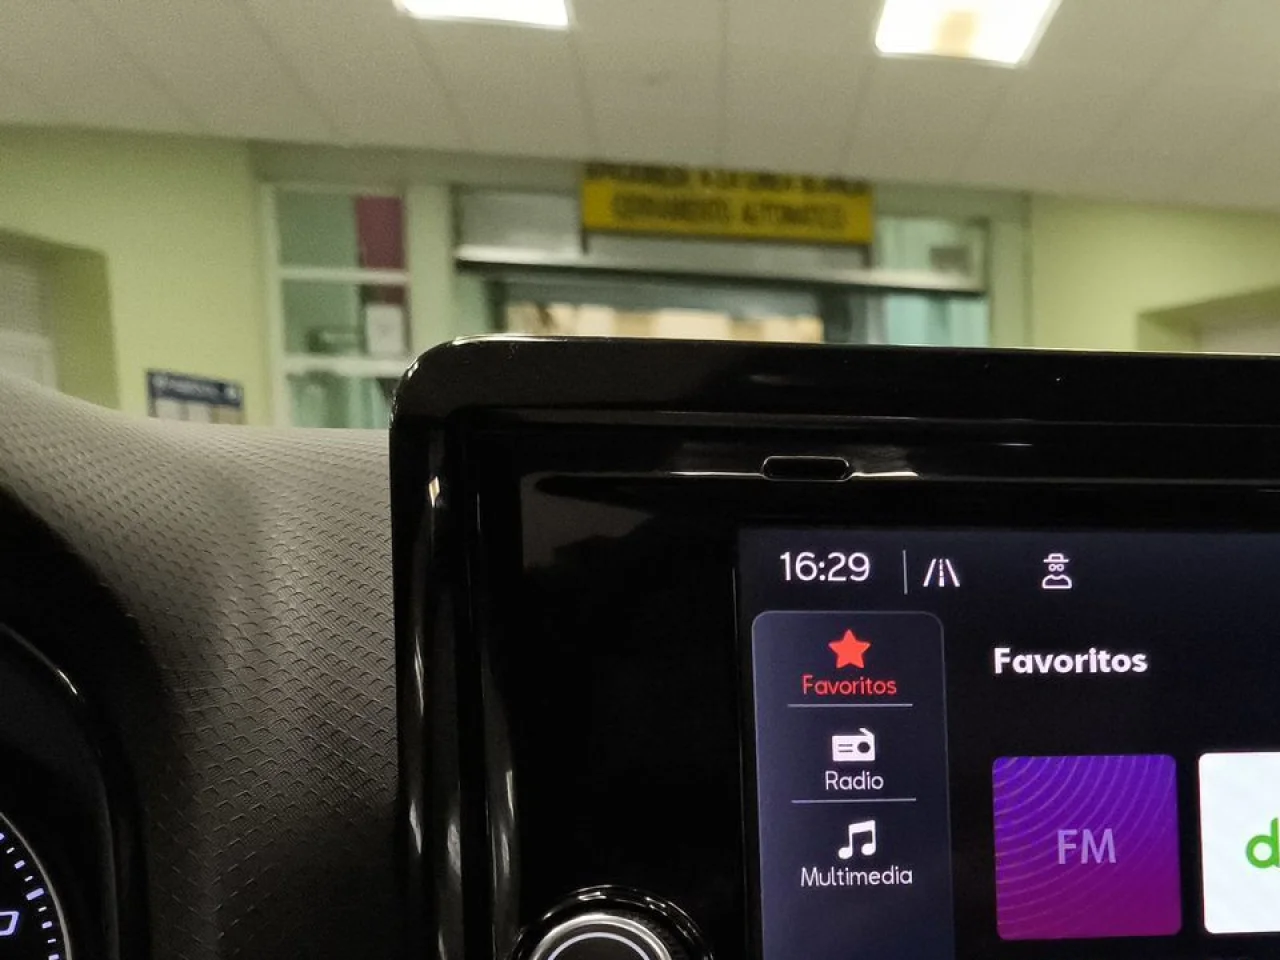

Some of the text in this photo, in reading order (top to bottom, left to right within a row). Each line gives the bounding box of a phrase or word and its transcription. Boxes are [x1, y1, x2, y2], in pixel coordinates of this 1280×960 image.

[780, 551, 871, 582] 16:29
[993, 646, 1149, 675] Favoritos
[801, 674, 898, 697] Favoritos
[824, 770, 885, 791] Radio
[1057, 827, 1118, 866] FM
[800, 865, 914, 888] Multimedia
